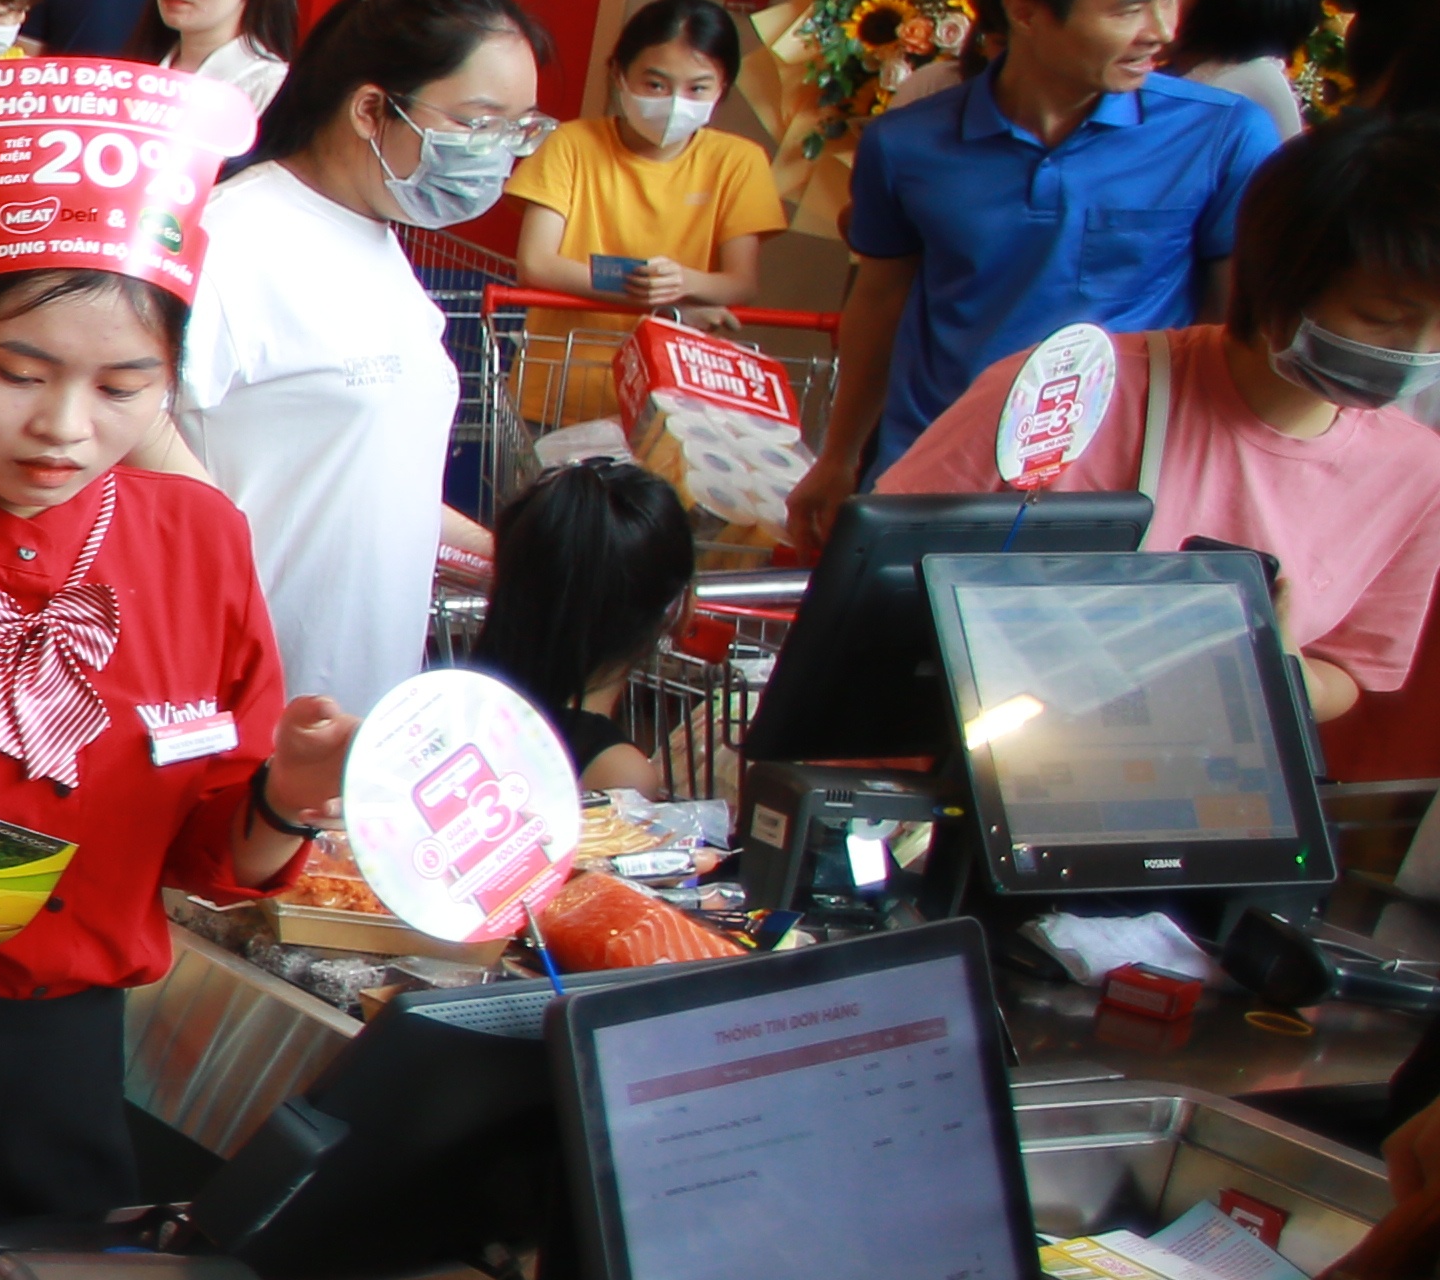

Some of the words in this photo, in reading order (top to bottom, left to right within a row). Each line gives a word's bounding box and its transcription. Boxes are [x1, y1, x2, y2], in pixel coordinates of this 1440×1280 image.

[19, 62, 69, 86] ĐÃI
[73, 64, 133, 92] ĐẶC
[51, 91, 118, 116] VIÊN
[4, 135, 34, 149] TIẾT
[32, 129, 197, 206] 20%
[5, 207, 55, 226] MEAT
[106, 209, 127, 228] &
[48, 238, 101, 255] TOÀN
[102, 240, 130, 261] BỘ
[678, 343, 734, 374] Mua
[1144, 858, 1183, 869] POSBANK
[764, 1017, 787, 1036] TIN
